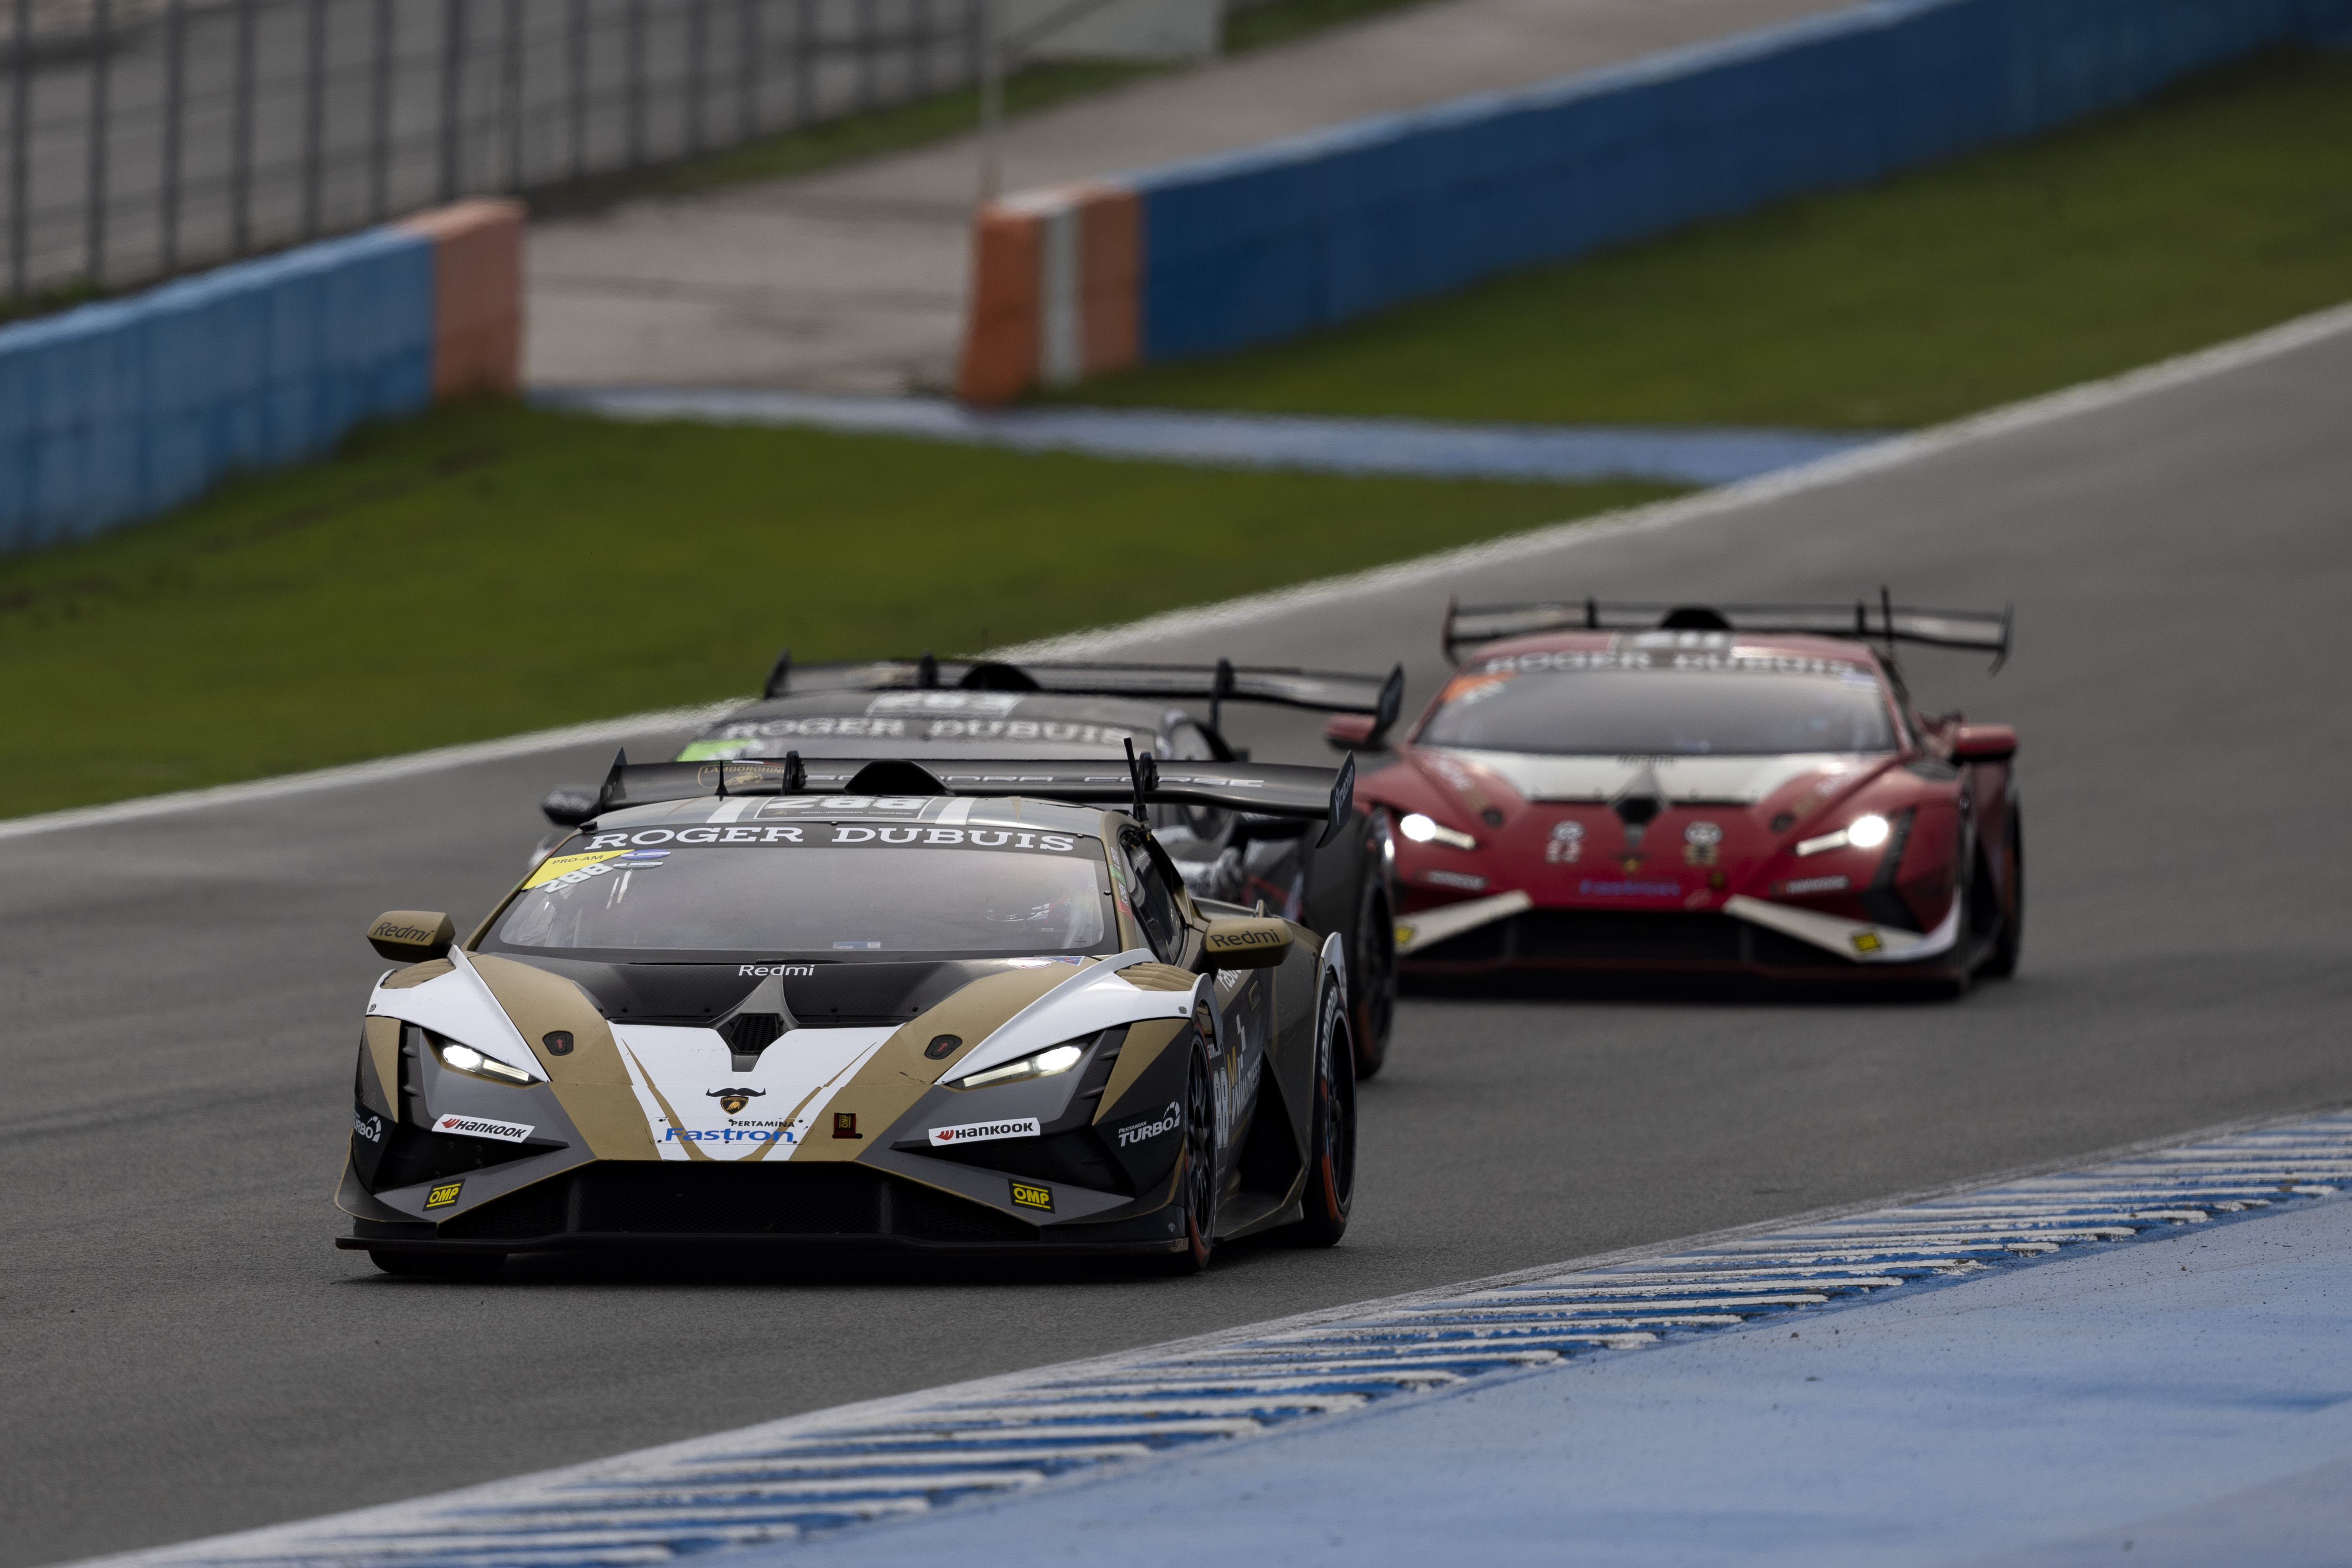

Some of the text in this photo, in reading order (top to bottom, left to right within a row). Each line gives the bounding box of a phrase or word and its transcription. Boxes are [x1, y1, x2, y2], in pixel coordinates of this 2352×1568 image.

[764, 798, 928, 809] 288
[584, 827, 1074, 852] ROGER DUBUIS
[552, 855, 604, 865] PRO-AM
[535, 862, 614, 893] 288
[374, 922, 435, 943] Redmi
[1210, 929, 1281, 948] Redmi
[738, 964, 815, 976] Redmi
[665, 1127, 794, 1142] Fastron
[1118, 1117, 1173, 1147] TURBO
[1119, 1120, 1147, 1134] PERTAMAX
[428, 1185, 460, 1204] OMP
[1014, 1187, 1050, 1205] OMP
